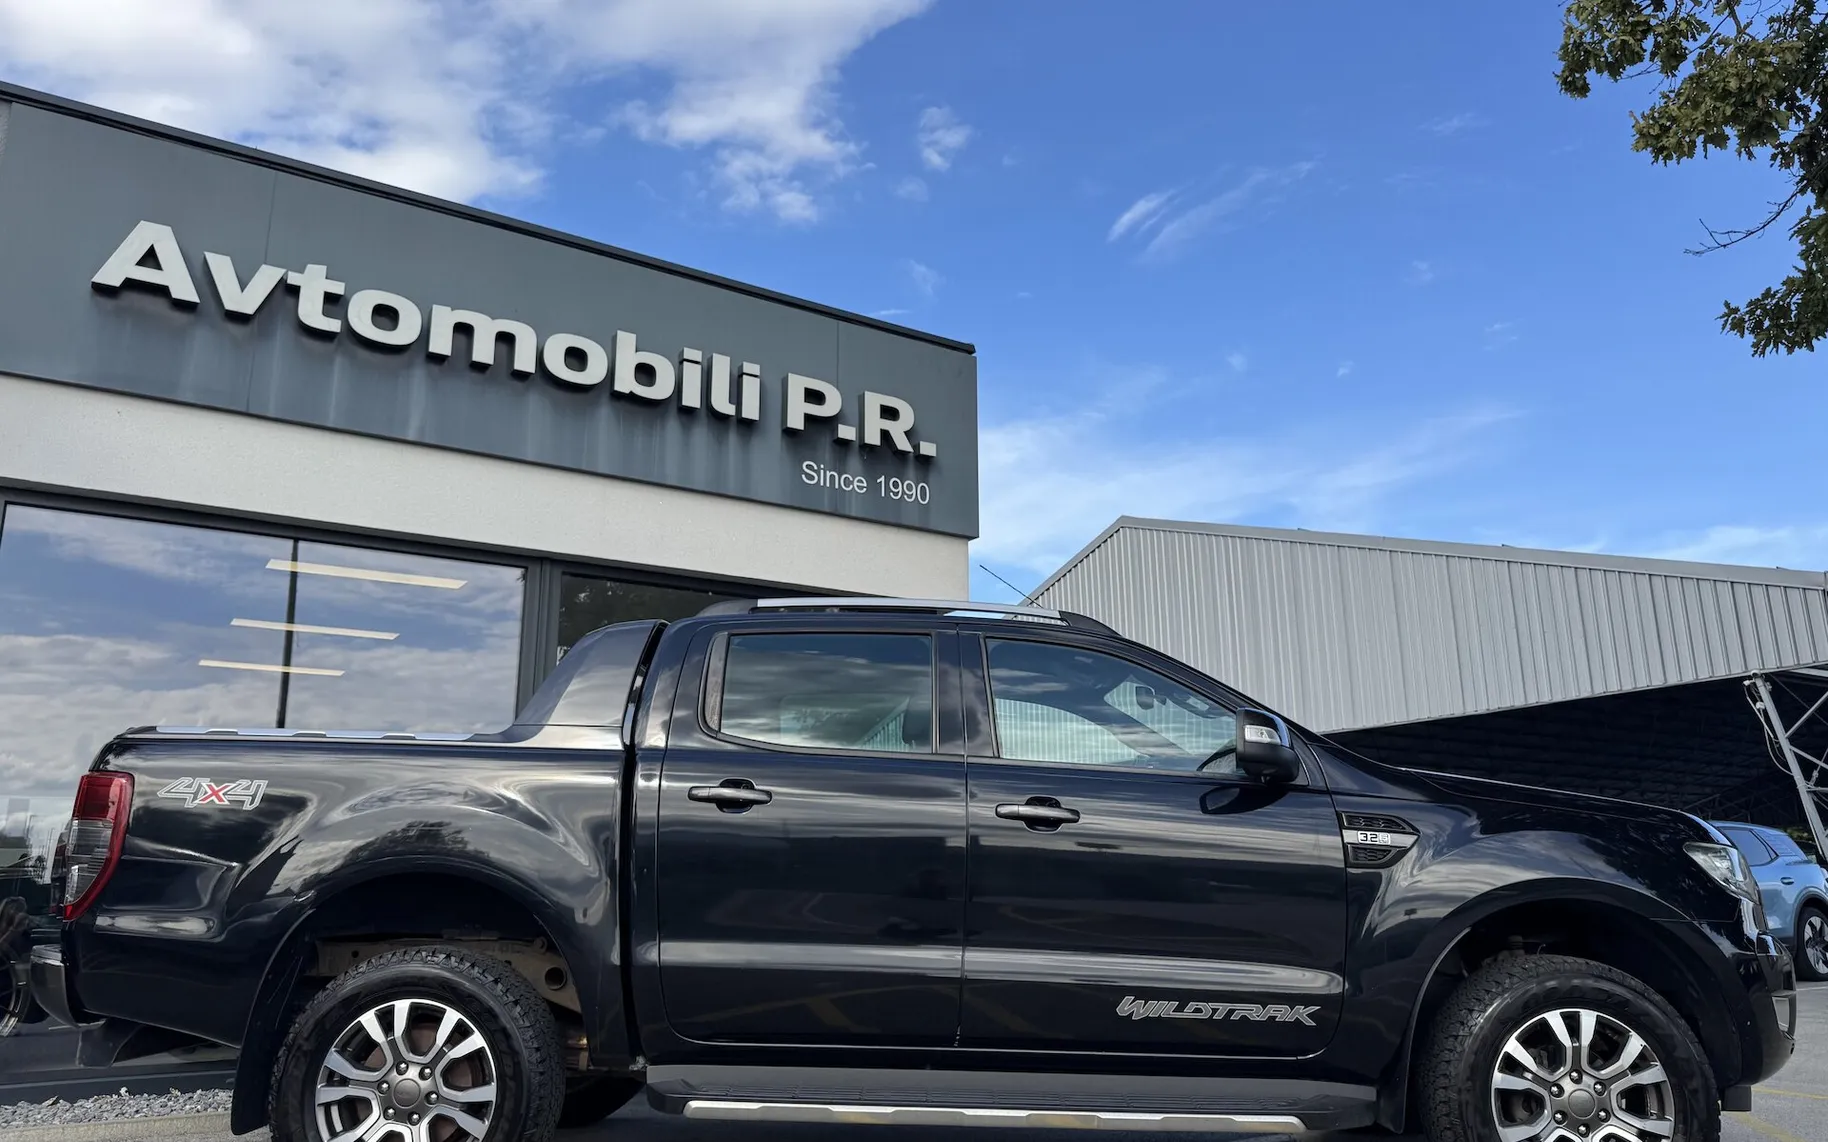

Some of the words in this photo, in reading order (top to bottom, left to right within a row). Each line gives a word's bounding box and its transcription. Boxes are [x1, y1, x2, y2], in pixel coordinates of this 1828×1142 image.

[91, 220, 761, 422] Avtomobili
[785, 372, 937, 458] P.R.
[801, 461, 867, 493] Since
[876, 475, 930, 504] 1990
[1116, 996, 1321, 1026] WILDTRAK
